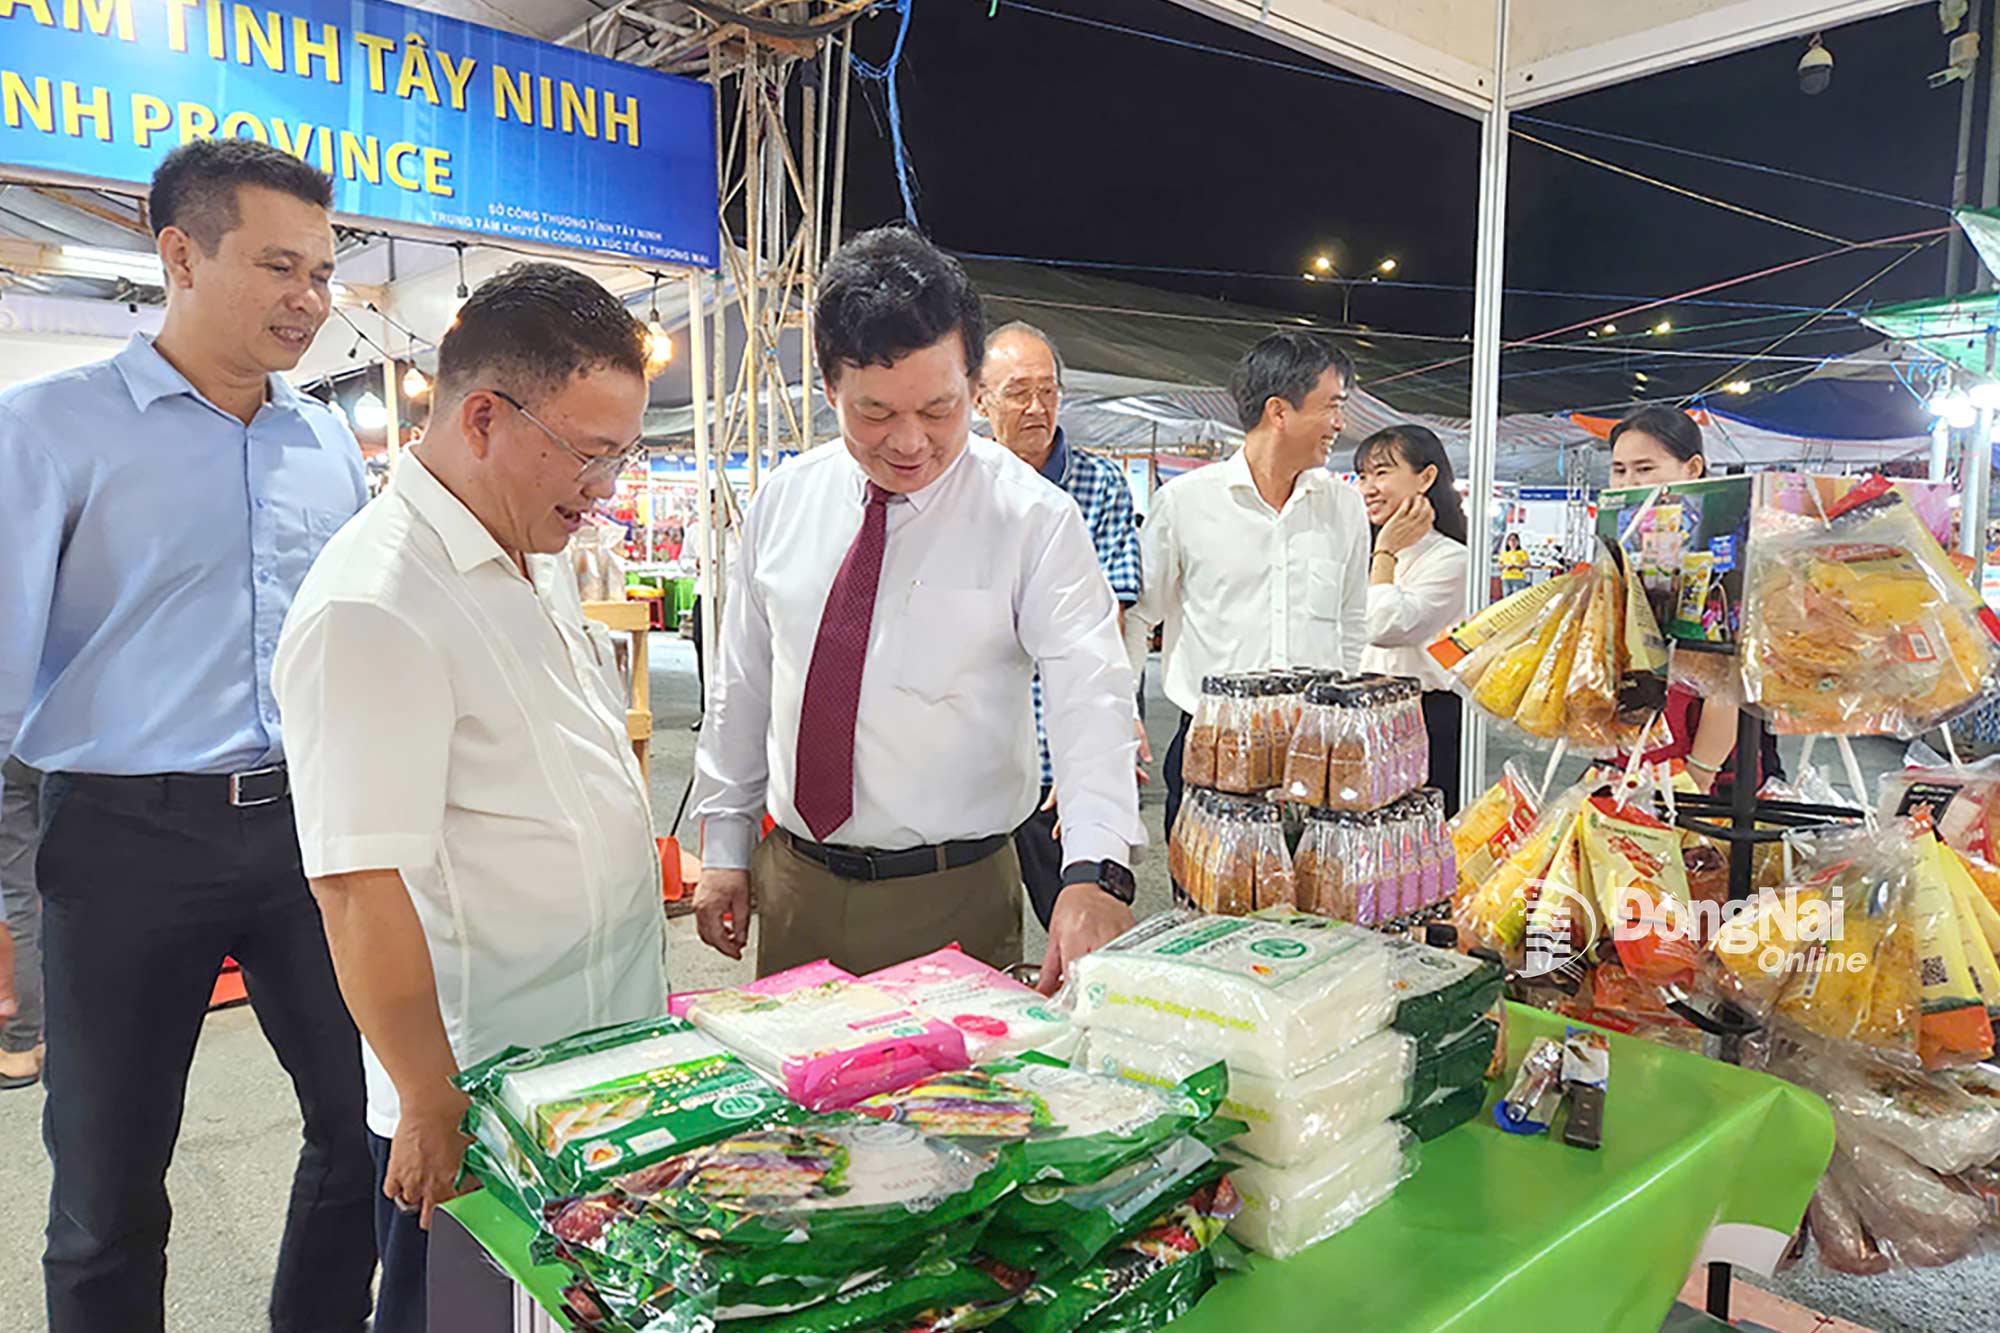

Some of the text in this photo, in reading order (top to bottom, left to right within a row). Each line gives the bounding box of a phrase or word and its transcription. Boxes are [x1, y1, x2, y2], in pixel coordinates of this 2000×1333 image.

[1, 69, 112, 142] NH
[354, 32, 477, 111] TÂY
[492, 63, 641, 147] NINH
[432, 211, 474, 228] TRUNG
[637, 228, 662, 241] NINH
